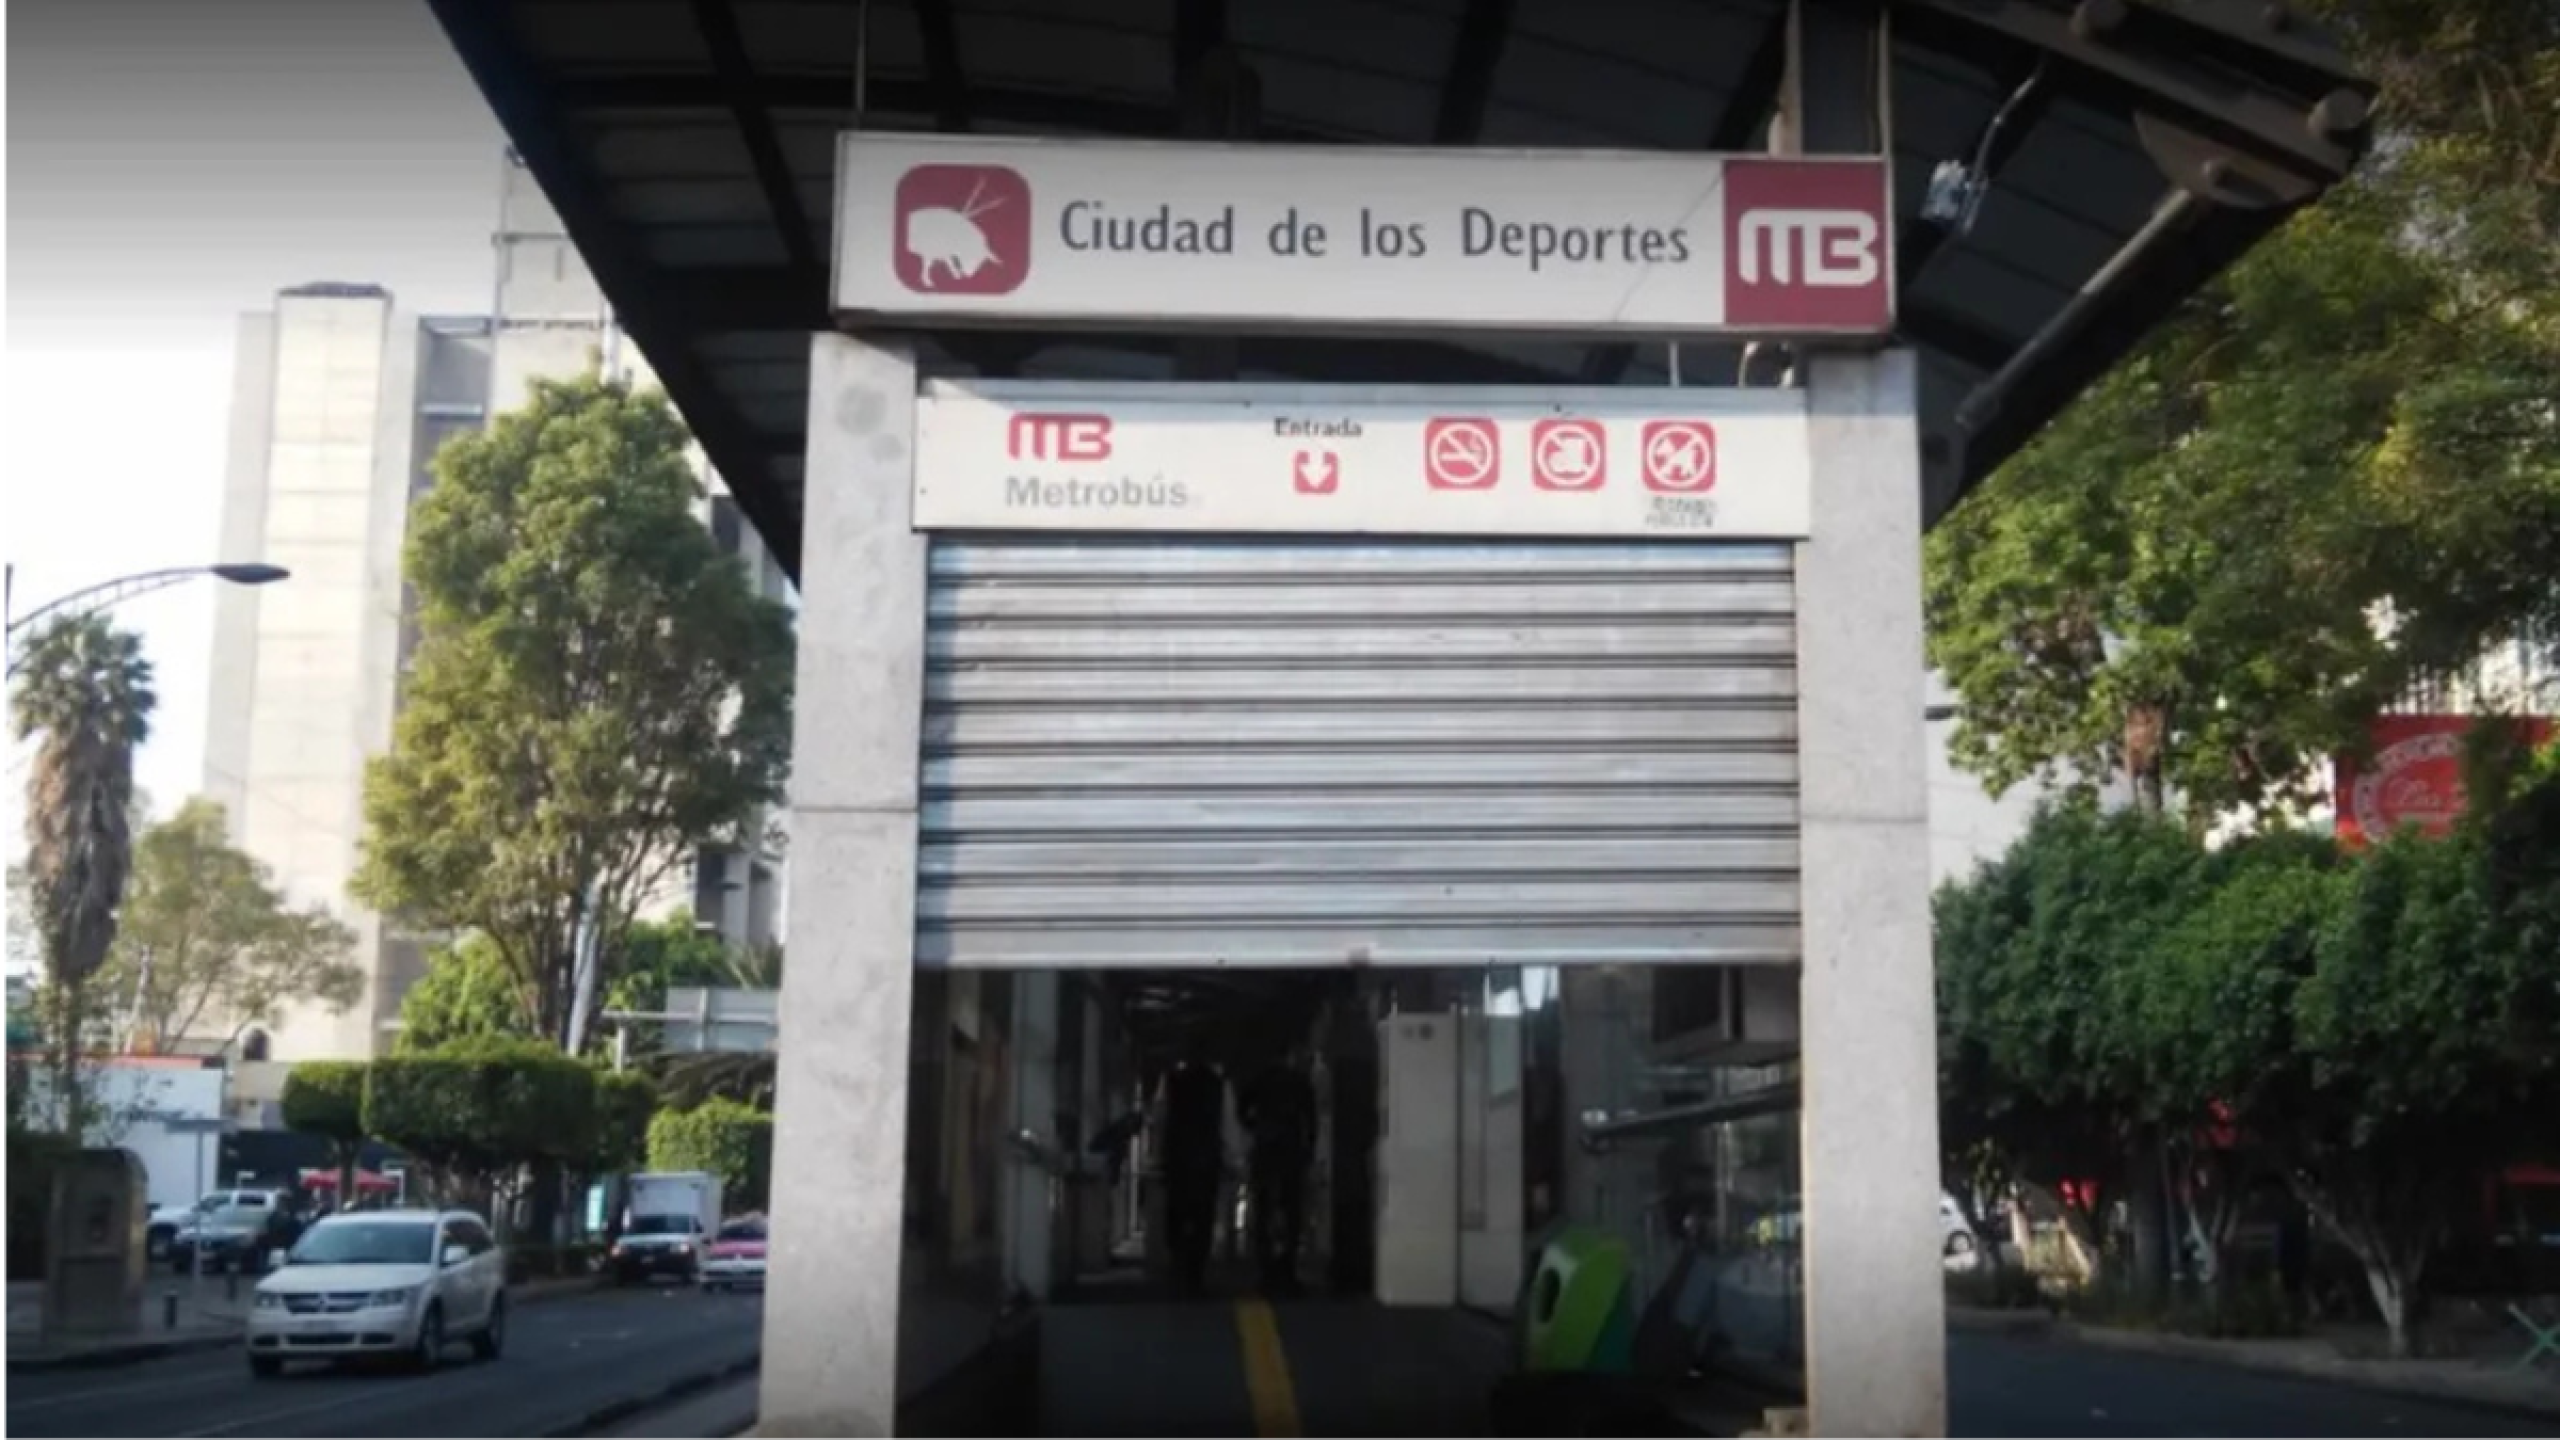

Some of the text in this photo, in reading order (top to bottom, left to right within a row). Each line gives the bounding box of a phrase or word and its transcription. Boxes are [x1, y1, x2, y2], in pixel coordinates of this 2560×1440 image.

[1060, 200, 1690, 271] Ciudad de los Deportes
[1738, 208, 1879, 287] MB
[1008, 412, 1113, 461] MB
[1274, 417, 1363, 437] Entrada
[1006, 470, 1188, 508] Metrobús
